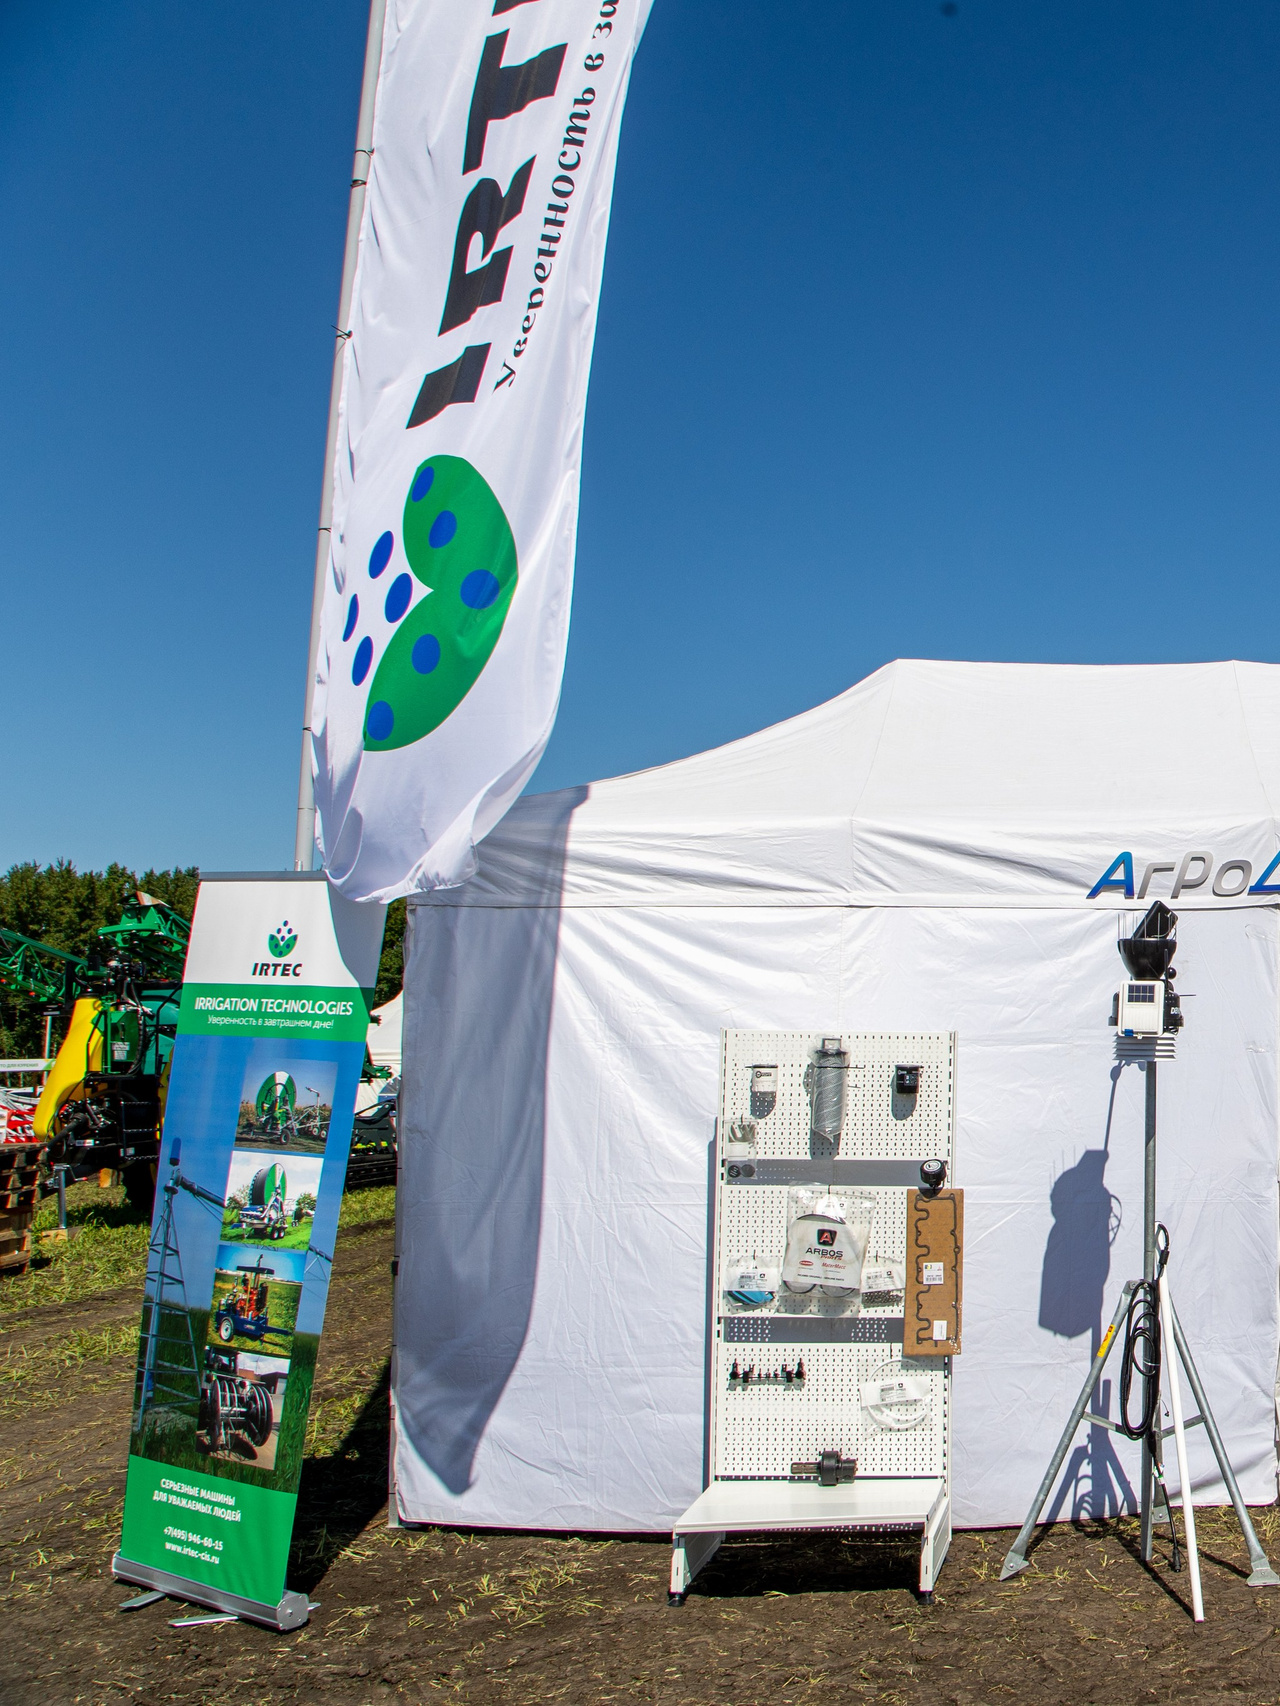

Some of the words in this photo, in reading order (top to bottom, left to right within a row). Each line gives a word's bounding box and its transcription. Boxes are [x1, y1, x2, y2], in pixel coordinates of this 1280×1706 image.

[406, 0, 569, 429] IRT
[493, 87, 597, 393] Уверенность
[584, 53, 605, 72] в
[252, 963, 303, 977] IRTEC
[195, 998, 257, 1012] IRRIGATION
[261, 999, 353, 1016] TECHNOLOGIES
[208, 1015, 257, 1026] Уверенность
[264, 1019, 312, 1028] завтрашнем
[313, 1020, 334, 1029] дне!
[806, 1247, 844, 1258] ARBOS
[160, 1478, 200, 1498] СЕРЬЕЗНЫЕ
[200, 1489, 236, 1507] МАШИНЫ
[153, 1490, 167, 1503] ДЛЯ
[168, 1494, 213, 1515] УВАЖАЕМЫХ
[213, 1505, 241, 1523] ЛЮДЕЙ
[165, 1541, 220, 1565] www.irtec-cis.ru
